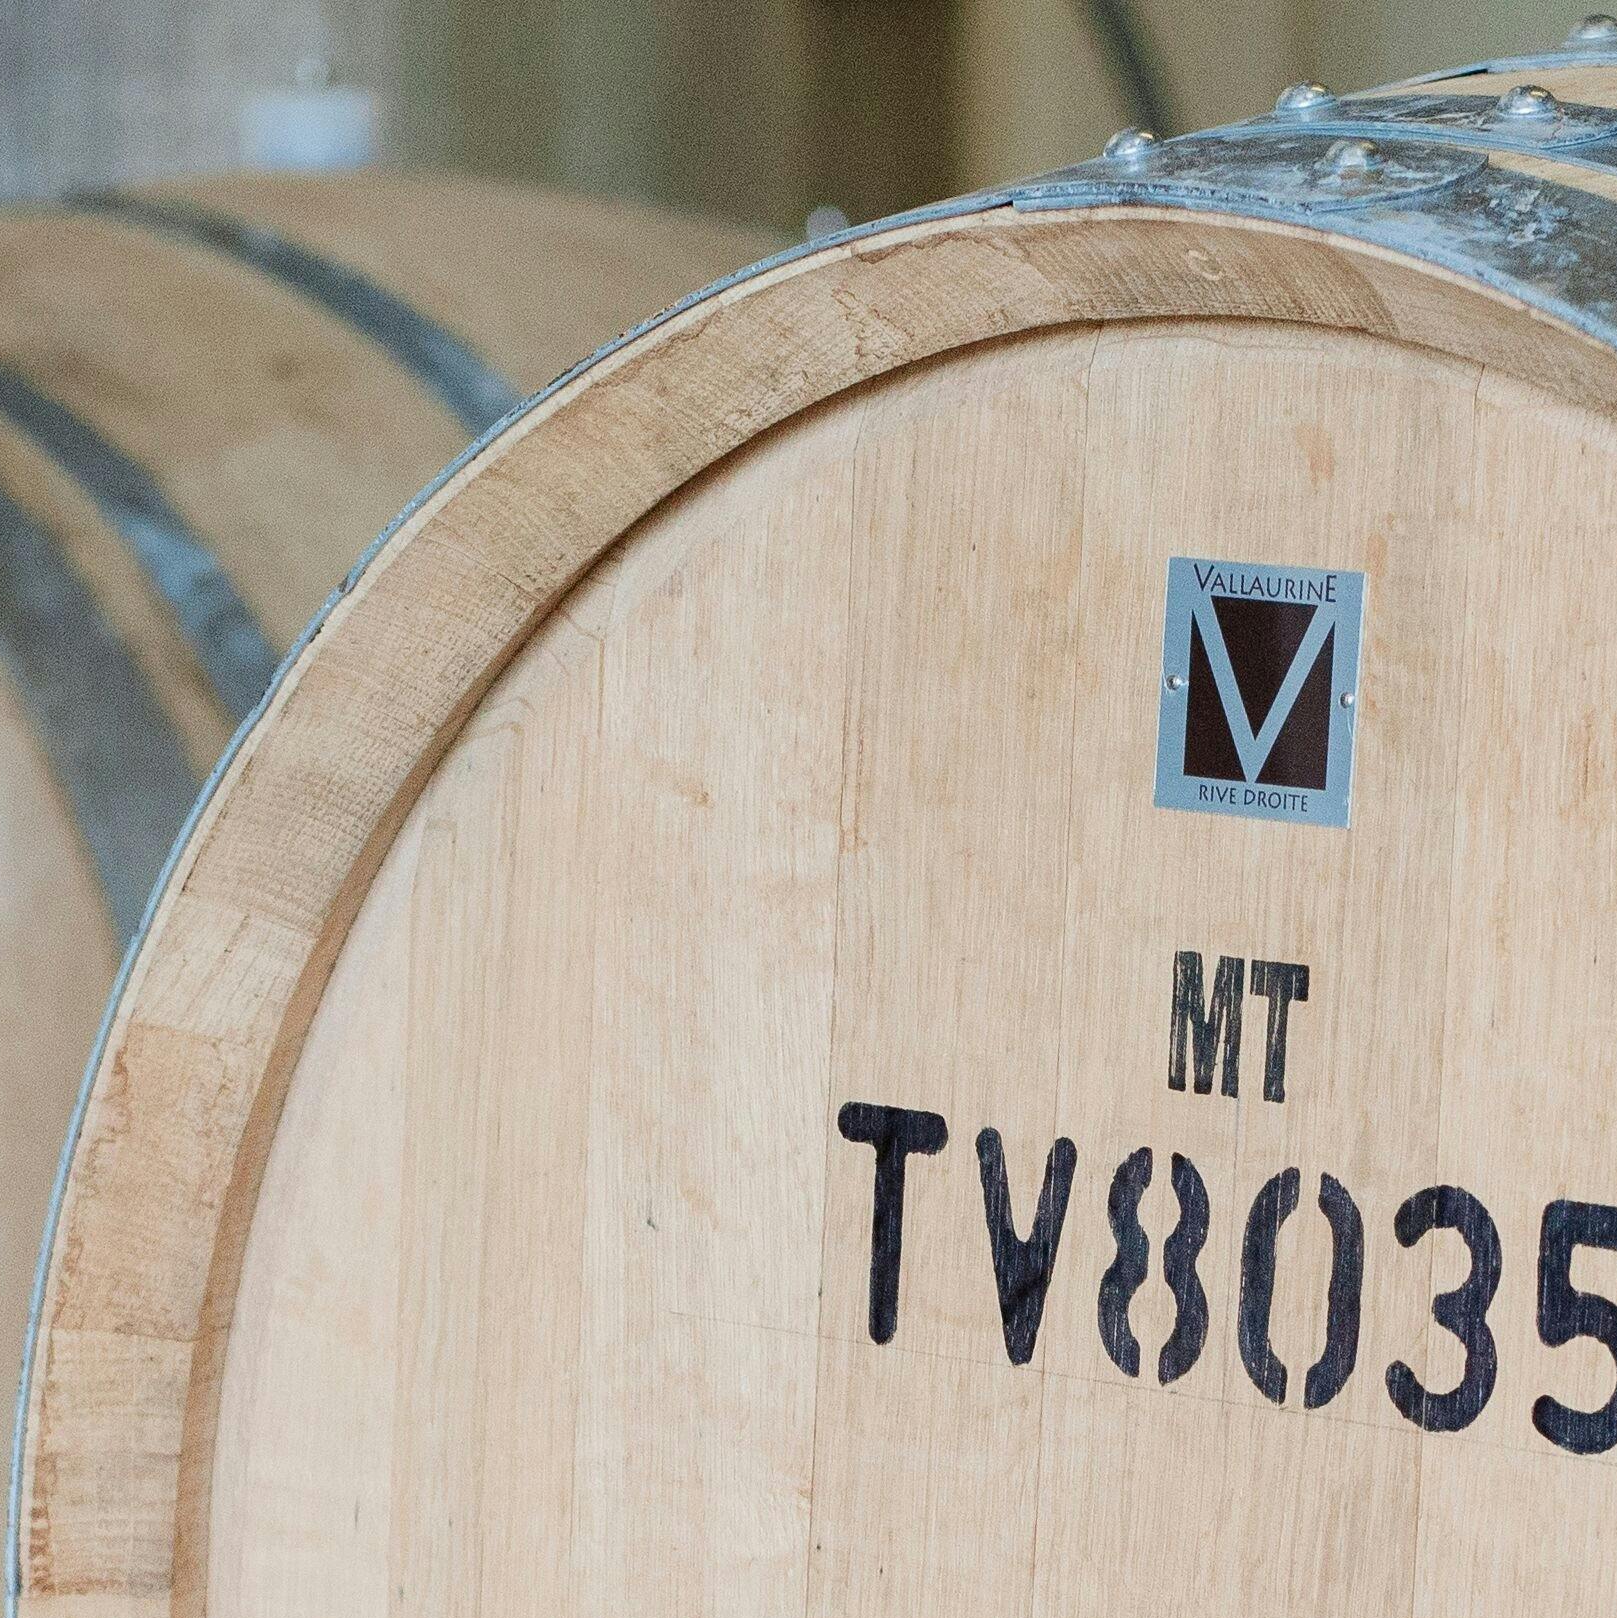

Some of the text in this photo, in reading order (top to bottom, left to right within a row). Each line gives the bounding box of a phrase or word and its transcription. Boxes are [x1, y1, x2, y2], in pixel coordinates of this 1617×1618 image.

[1199, 784, 1309, 812] RIVE DROITE
[1168, 951, 1310, 1103] MT
